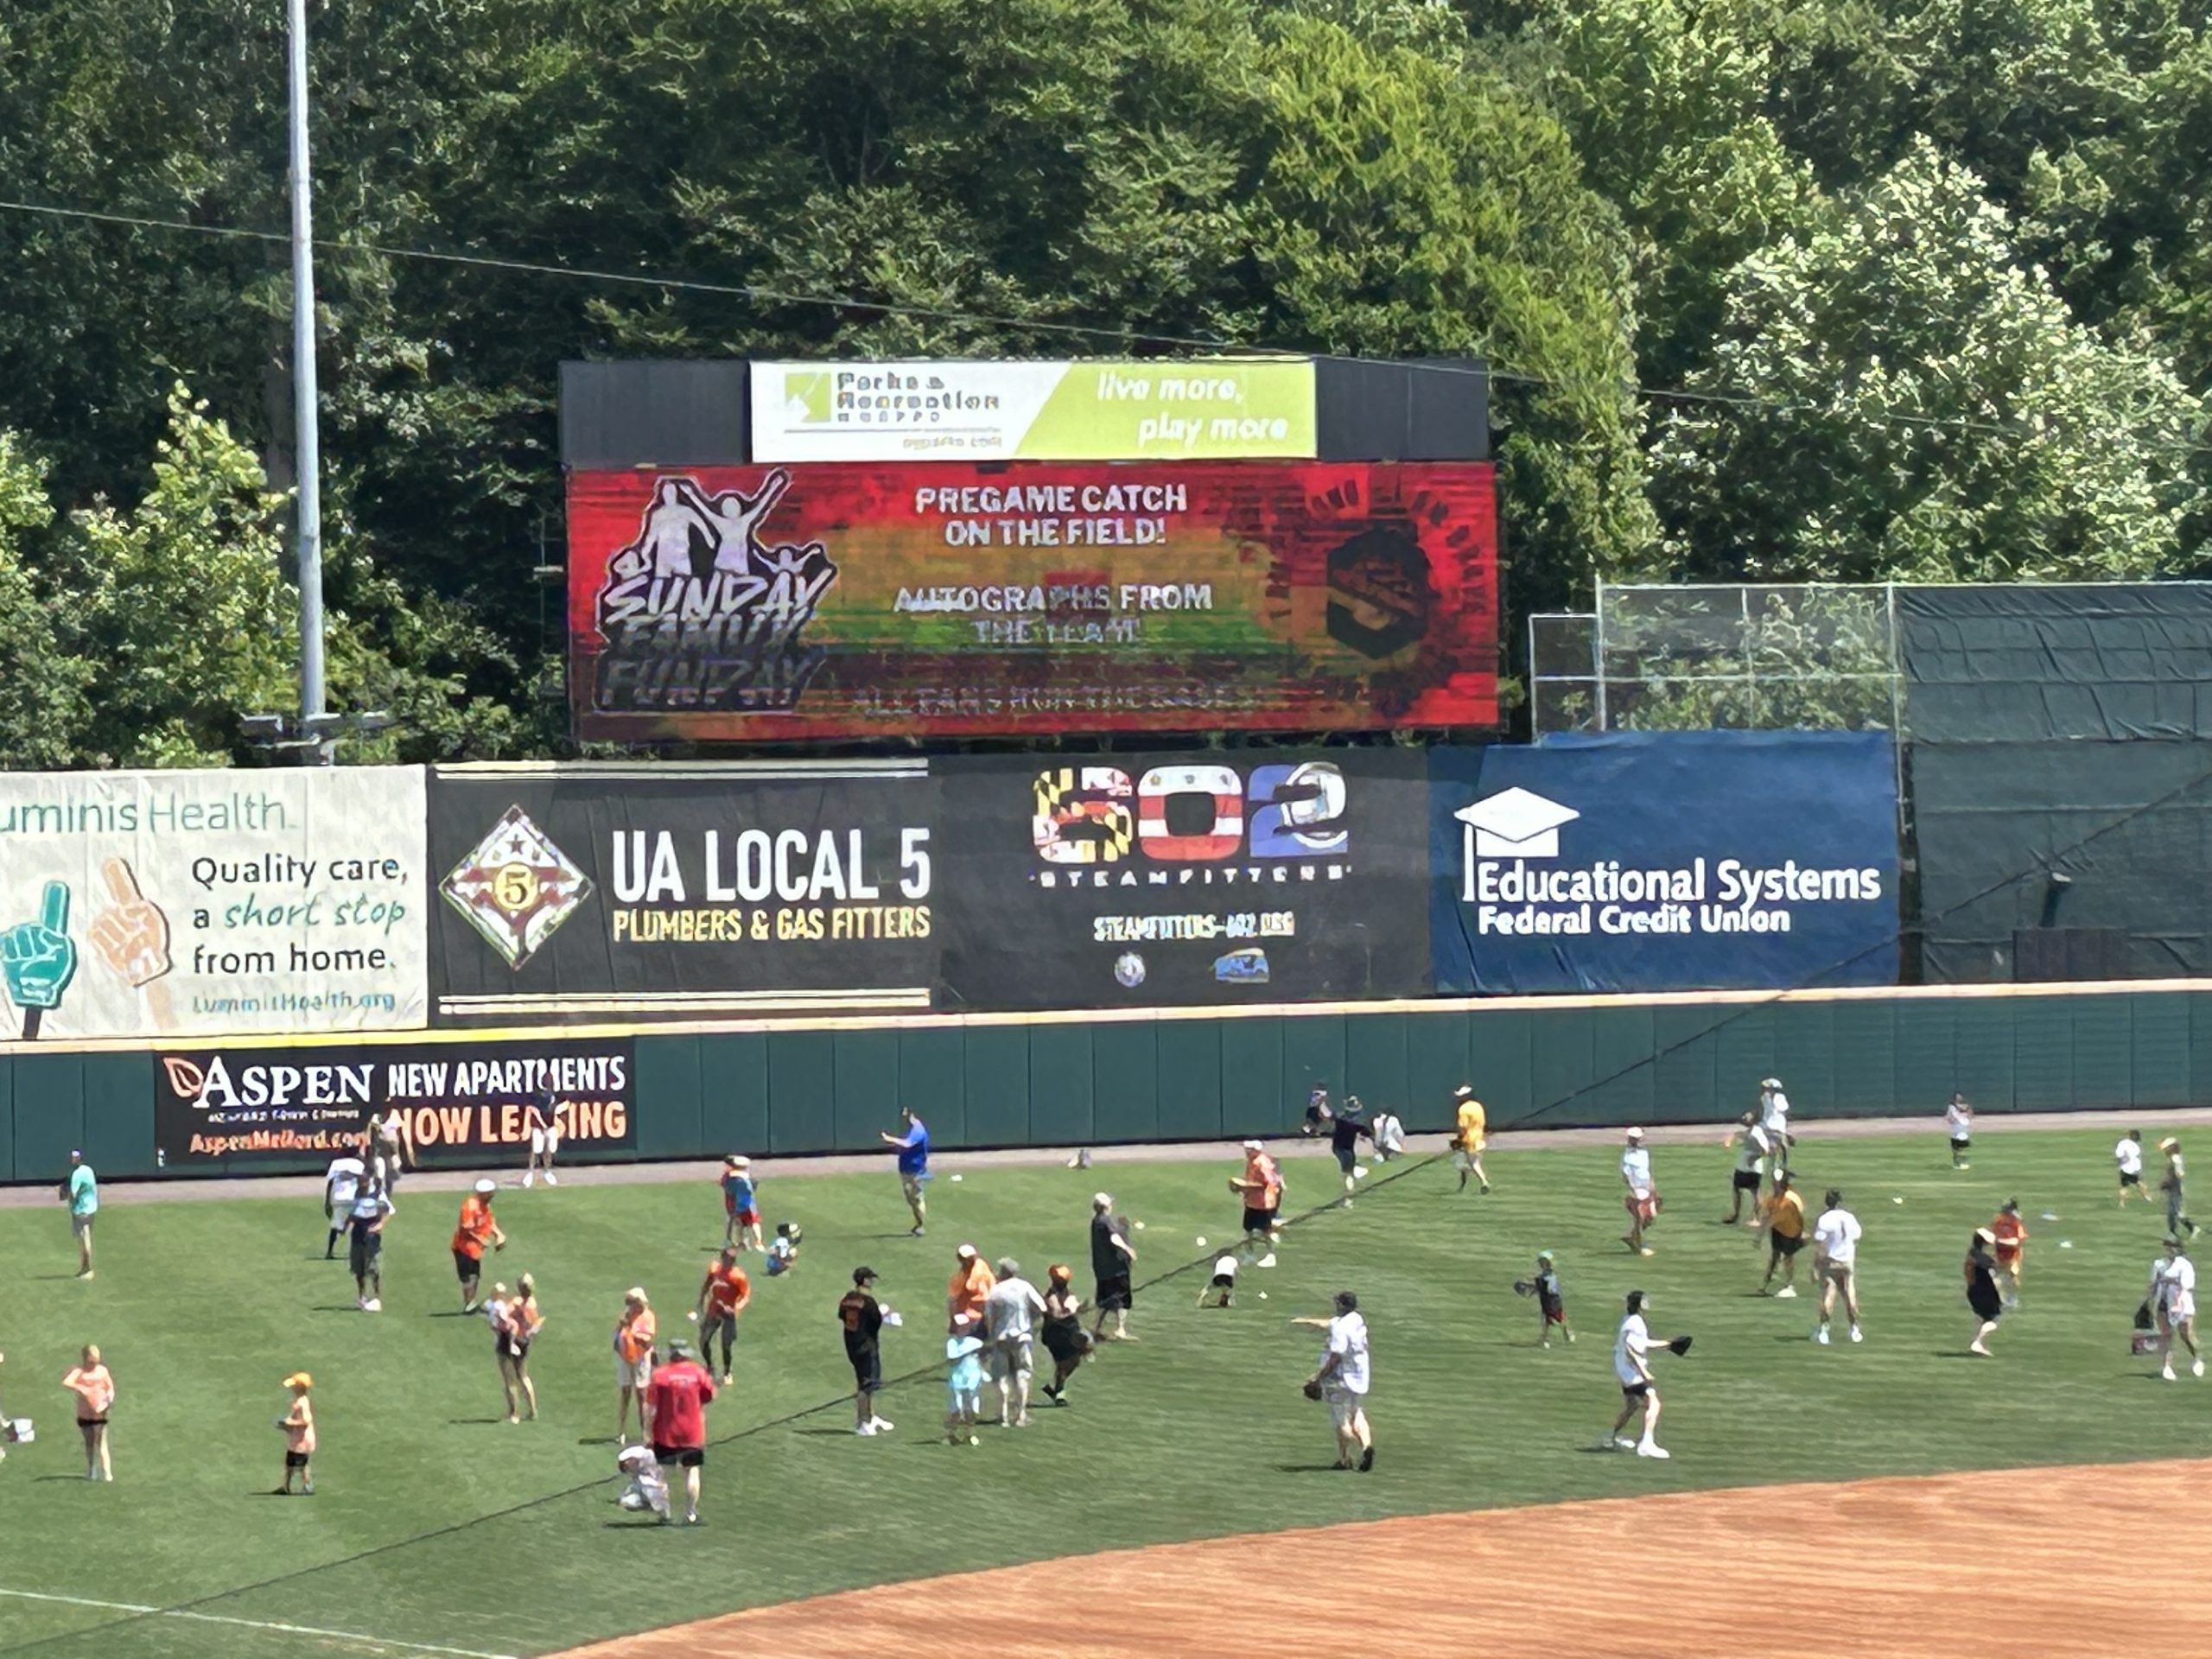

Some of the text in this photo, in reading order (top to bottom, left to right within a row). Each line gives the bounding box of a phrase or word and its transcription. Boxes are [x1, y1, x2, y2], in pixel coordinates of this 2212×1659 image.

[1096, 370, 1151, 401] live
[1138, 410, 1288, 449] play more
[915, 484, 1187, 514] PREGAME CATCH
[945, 518, 1166, 547] ON THE FIELD!
[604, 567, 837, 626] SUNDAY
[893, 583, 1213, 613] AUTOGRAPHS FROM
[149, 792, 287, 832] Health
[1032, 761, 1349, 864] 602
[192, 855, 409, 890] Quality care,
[613, 826, 931, 903] UA LOCAL 5
[1478, 858, 1882, 907] Educational Systems
[504, 871, 528, 905] 5
[193, 892, 405, 935] a short stop
[613, 905, 931, 942] PLUMBERS & GAS FITTERS
[1478, 903, 1791, 935] Federal Credit Union
[193, 943, 397, 974] from home.
[388, 1055, 626, 1097] NEW APARTMENTS
[391, 1105, 472, 1146] NOW
